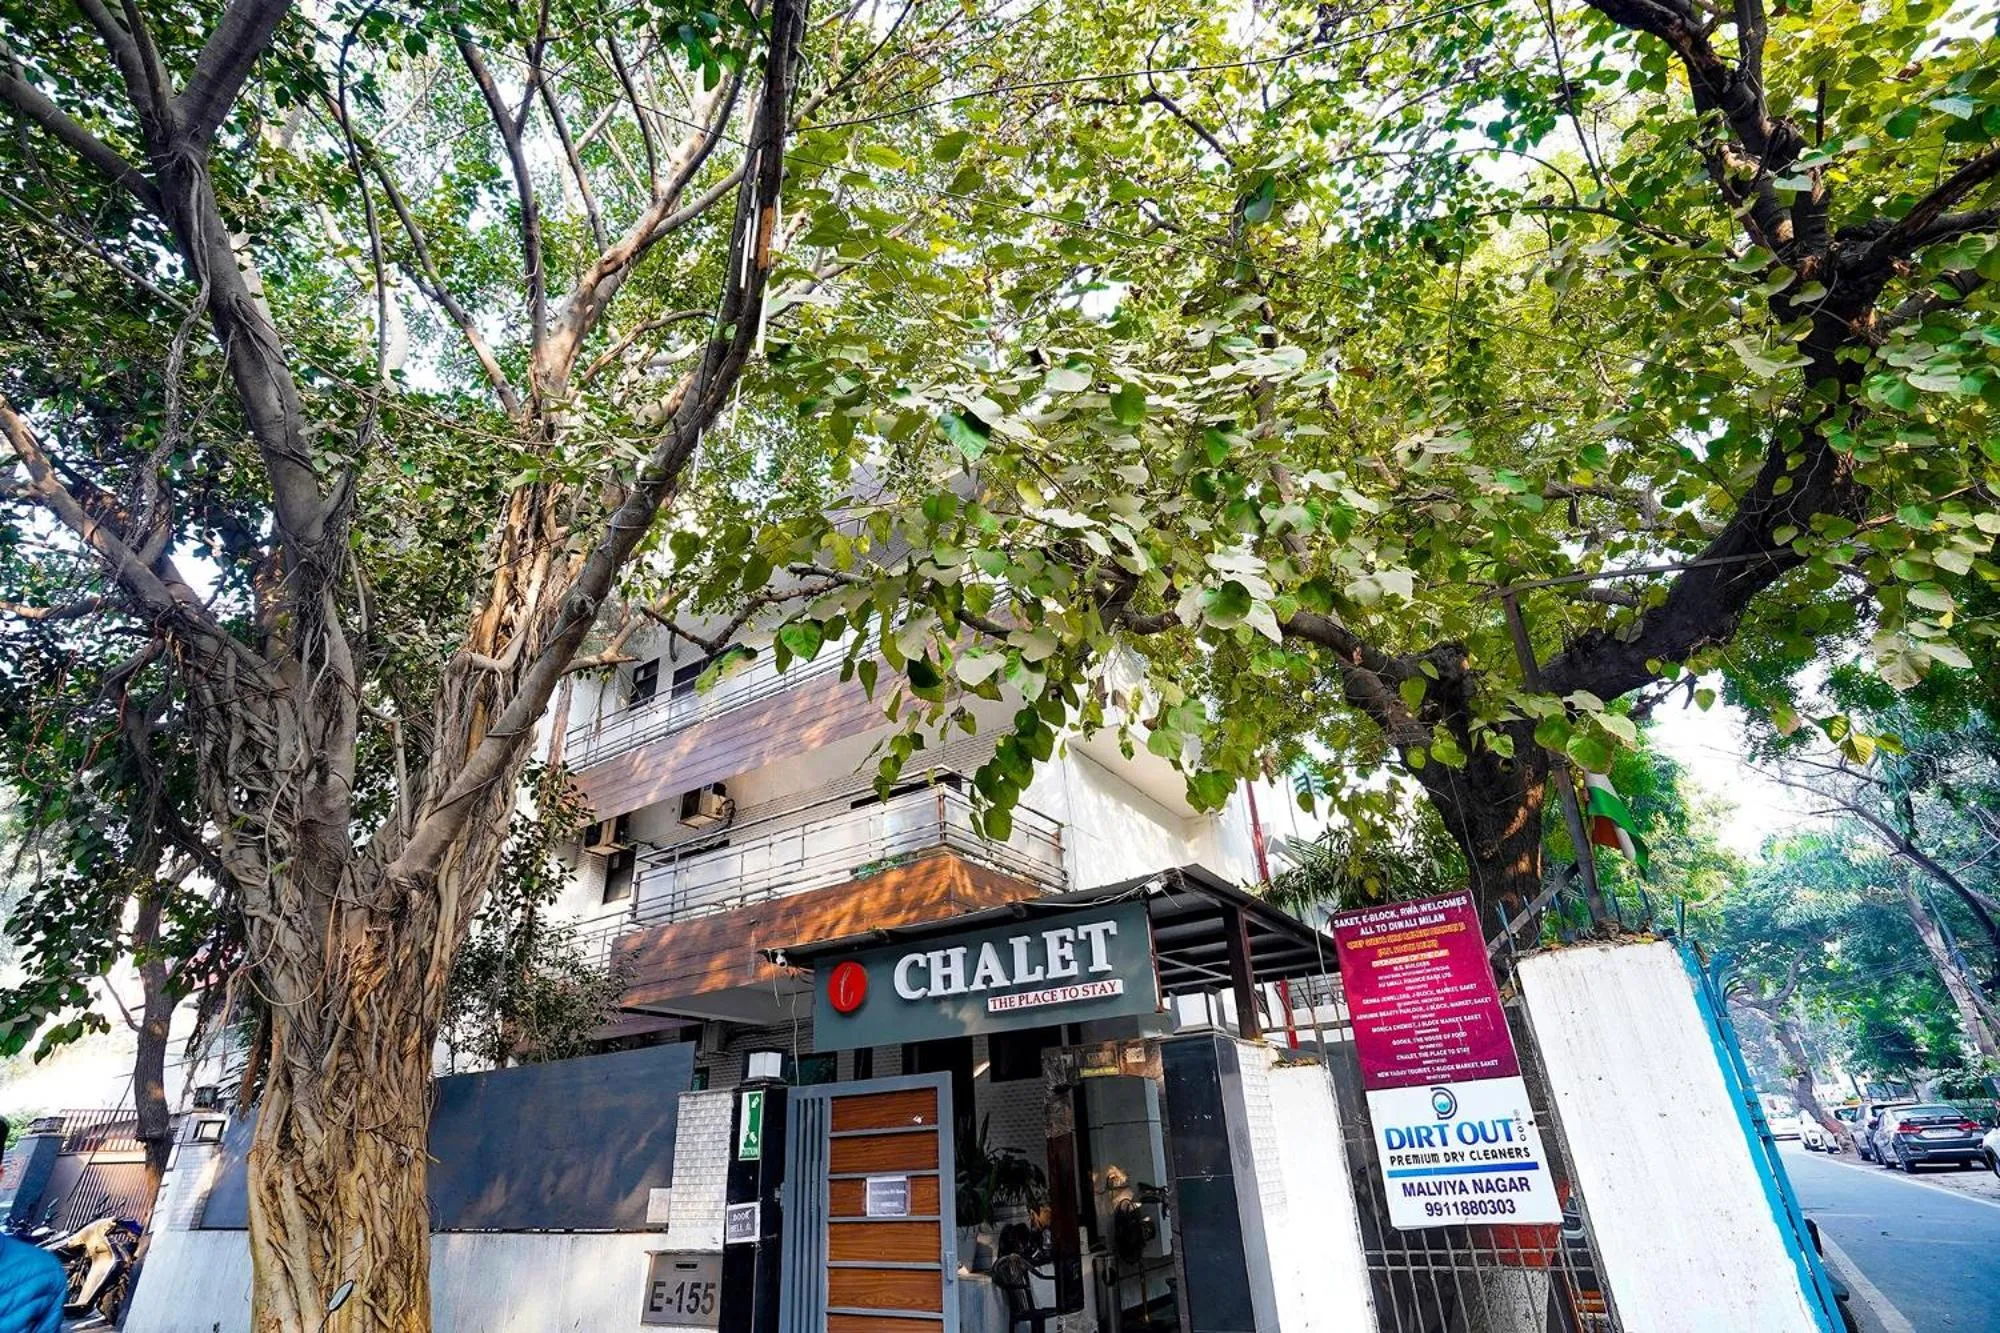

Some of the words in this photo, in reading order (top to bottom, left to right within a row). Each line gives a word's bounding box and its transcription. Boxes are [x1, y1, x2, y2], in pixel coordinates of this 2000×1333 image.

[1362, 910, 1399, 924] E-BLOCK,
[1400, 903, 1419, 916] RWA
[1420, 896, 1468, 912] WELCOMES
[1360, 926, 1375, 935] ALL
[1375, 923, 1388, 933] TO
[1389, 917, 1418, 931] DIWALI
[1418, 913, 1446, 926] MILAN
[894, 920, 1118, 1000] CHALET
[990, 997, 1016, 1010] THE
[1018, 989, 1058, 1006] PLACE
[1060, 987, 1079, 1000] TO
[1082, 981, 1117, 996] STAY
[1429, 1048, 1447, 1057] PLACE
[1480, 1059, 1498, 1067] SAKET
[1384, 1123, 1450, 1150] DIRT
[1456, 1118, 1515, 1145] OUT
[1389, 1152, 1441, 1166] PREMIUM
[1444, 1150, 1465, 1163] DRY
[1469, 1147, 1531, 1161] CLEANERS
[1402, 1178, 1470, 1197] MALVIYA
[1472, 1176, 1532, 1194] NAGAR
[1424, 1199, 1516, 1217] 9911880303
[649, 1280, 717, 1315] E-155
